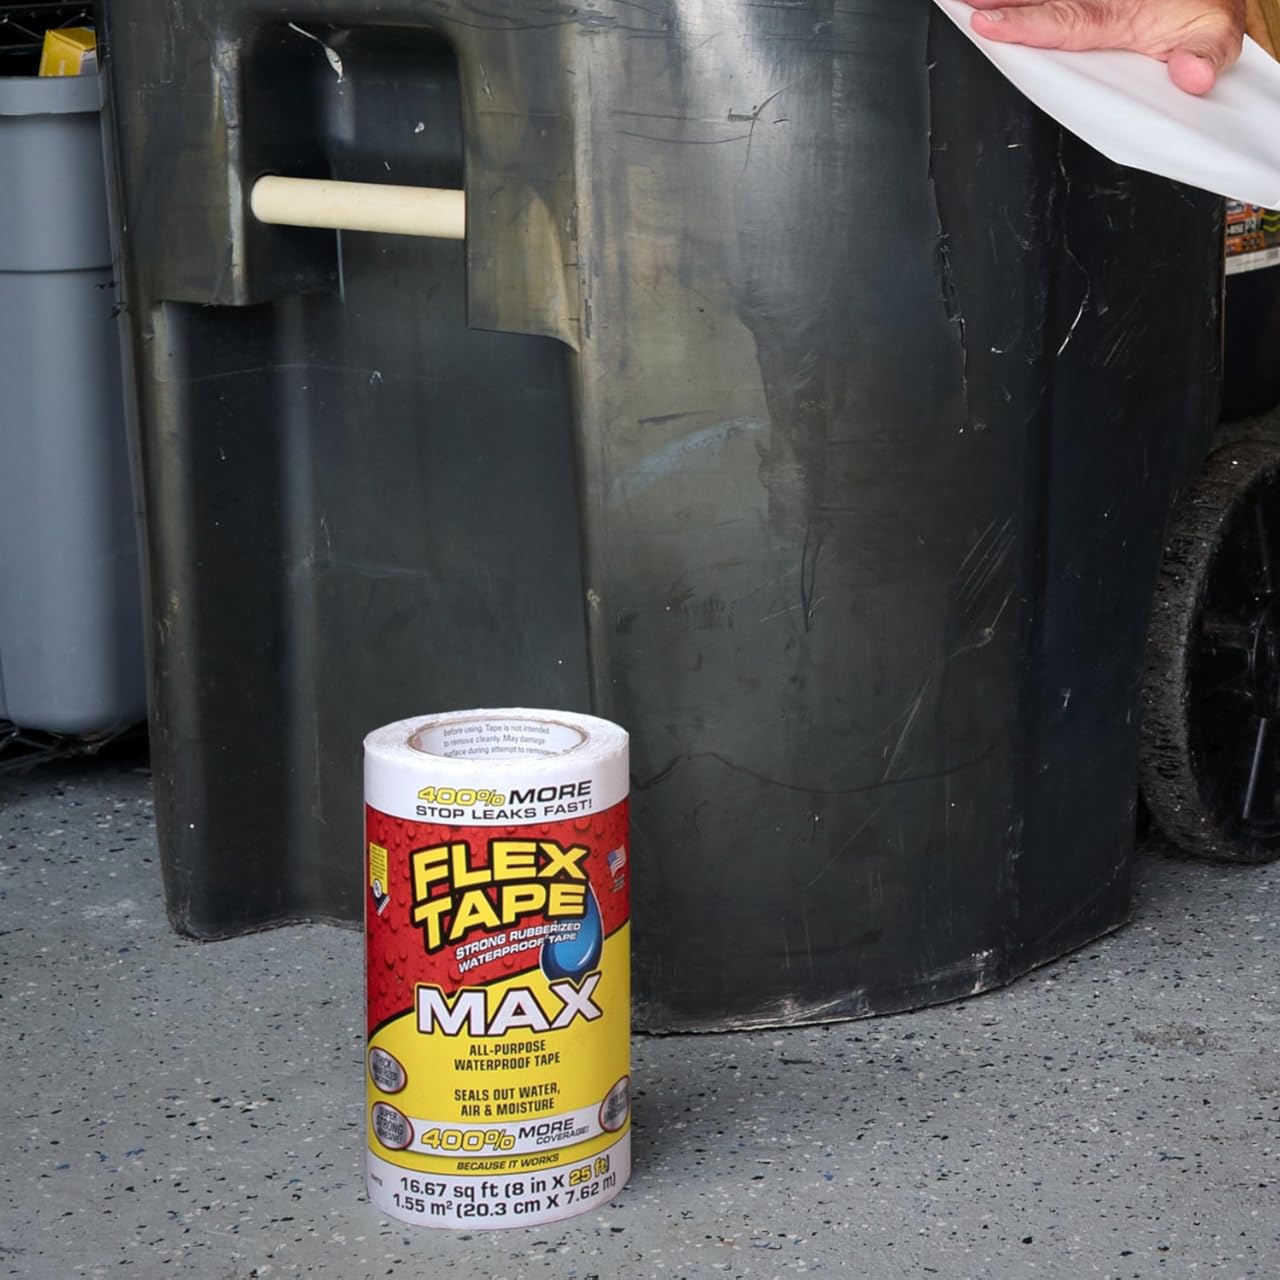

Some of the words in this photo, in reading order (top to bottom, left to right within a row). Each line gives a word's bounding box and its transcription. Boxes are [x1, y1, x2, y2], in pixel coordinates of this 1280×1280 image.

[444, 728, 463, 737] before
[486, 724, 502, 733] Tape
[504, 724, 509, 732] is
[511, 724, 522, 732] not
[523, 725, 550, 735] intended
[451, 738, 474, 746] remove
[503, 734, 519, 744] May
[520, 735, 546, 745] damage
[468, 746, 489, 756] during
[491, 746, 517, 755] attempt
[417, 785, 505, 807] 400%
[508, 780, 592, 805] MORE
[416, 805, 465, 819] STOP
[472, 807, 537, 820] LEAKS
[544, 799, 592, 816] FAST!
[411, 839, 589, 903] FLEX
[412, 883, 587, 950] TAPE
[456, 934, 506, 960] STRONG
[509, 922, 581, 942] RUBBERIZED
[458, 938, 544, 973] WATERPROOF
[549, 933, 577, 944] TAPE
[415, 972, 603, 1036] MAX
[469, 1040, 546, 1056] ALL-PURPOSE
[454, 1057, 530, 1071] WATERPROOF
[534, 1052, 560, 1067] TAPE
[454, 1089, 489, 1101] SEALS
[493, 1088, 515, 1100] OUT
[519, 1082, 560, 1099] WATER,
[461, 1105, 480, 1116] AIR
[484, 1104, 492, 1116] &
[496, 1098, 554, 1115] MOISTURE
[421, 1128, 516, 1151] 400%
[518, 1117, 575, 1139] MORE
[536, 1125, 590, 1145] COVERAGE!
[457, 1161, 505, 1171] BECAUSE
[508, 1159, 518, 1169] IT
[520, 1153, 559, 1169] WORKS
[400, 1177, 447, 1197] 16.67
[453, 1184, 475, 1202] sq
[481, 1181, 499, 1198] ft
[505, 1182, 524, 1199] (8
[531, 1177, 546, 1193] in
[551, 1175, 565, 1190] X
[568, 1165, 592, 1186] 25
[594, 1154, 610, 1178] ft)
[392, 1193, 425, 1214] 1.55
[456, 1202, 507, 1219] (20.3
[513, 1198, 541, 1215] cm
[546, 1194, 560, 1210] X
[565, 1181, 599, 1205] 7.62
[602, 1171, 616, 1191] m)
